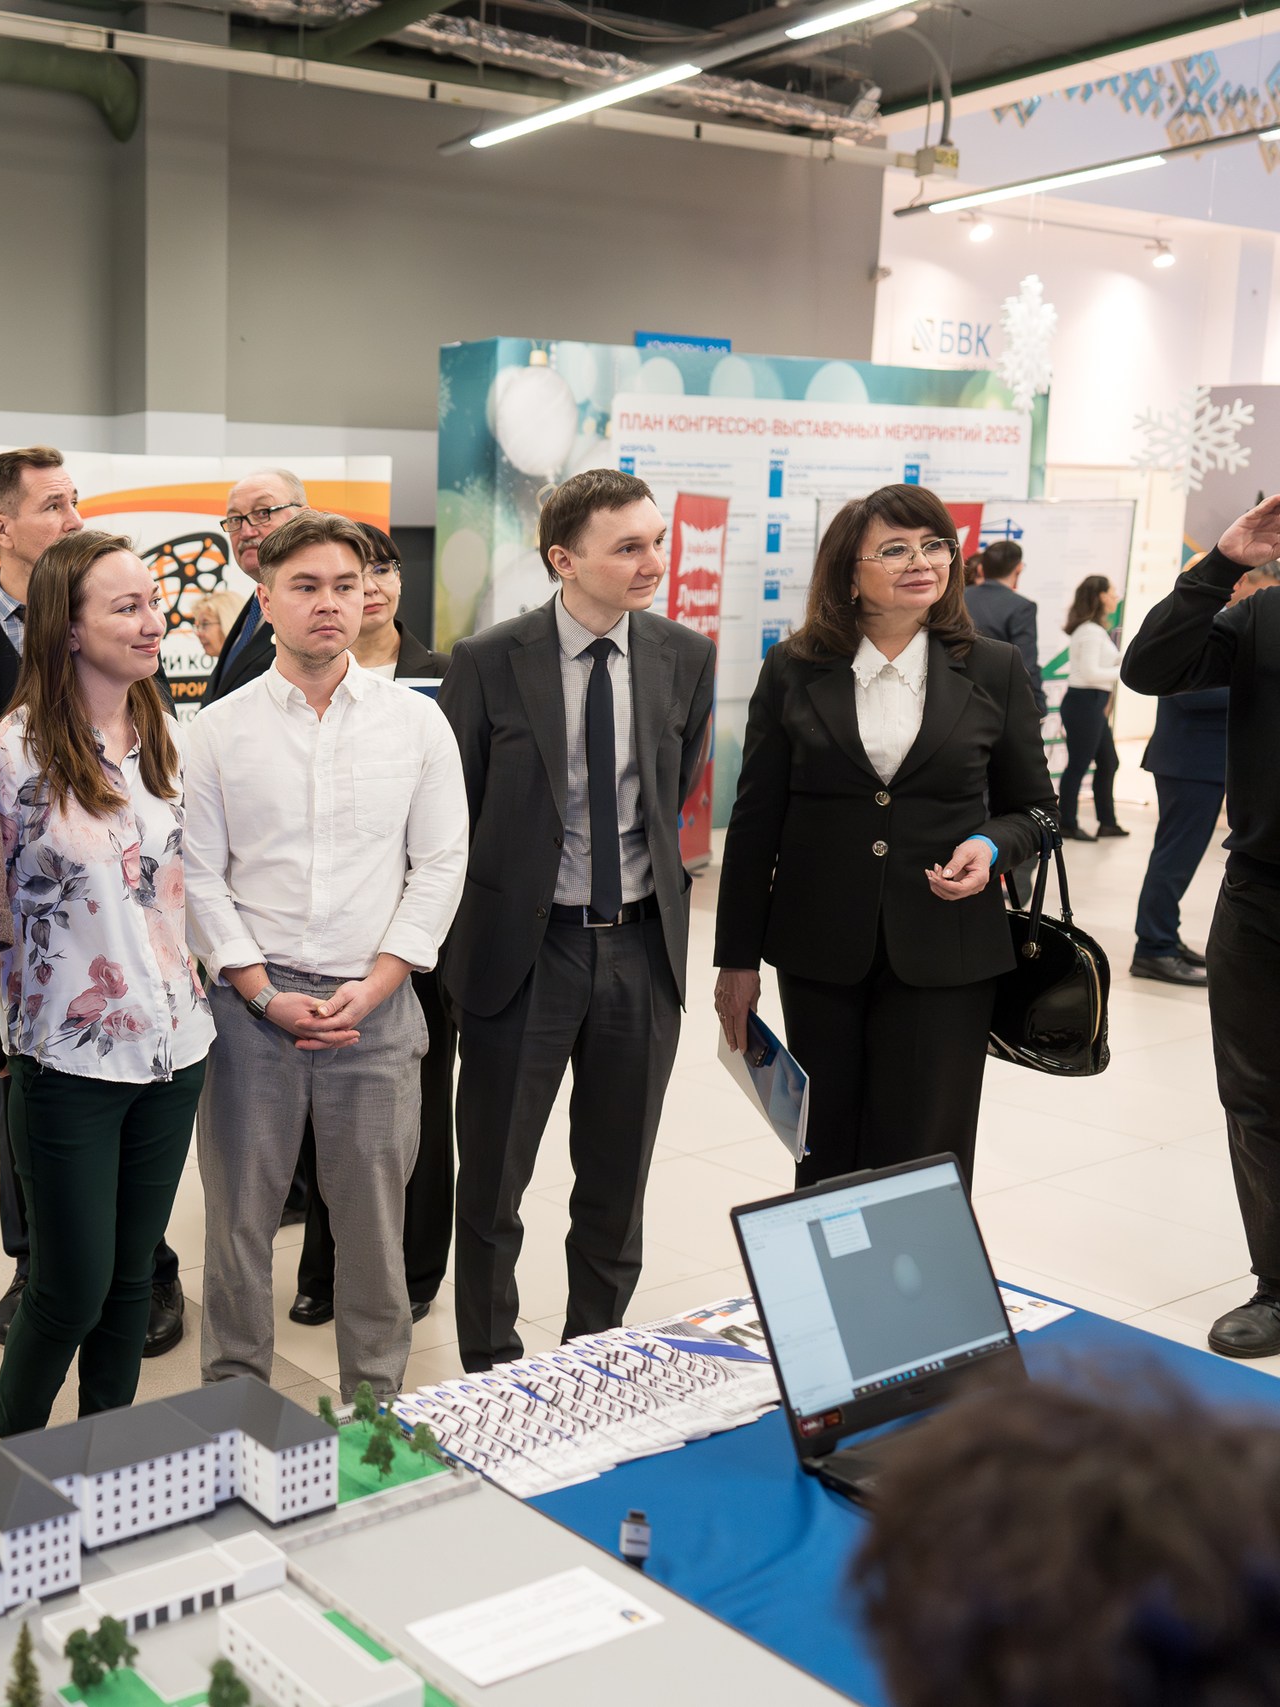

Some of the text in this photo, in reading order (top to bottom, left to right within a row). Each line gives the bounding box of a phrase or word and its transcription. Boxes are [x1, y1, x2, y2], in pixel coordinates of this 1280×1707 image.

[940, 320, 992, 357] БВК
[618, 411, 1021, 445] ПЛАН КОНГРЕССНО-ВЫСТАВОЧНЫХ МЕРОПРИЯТИЙ 2025
